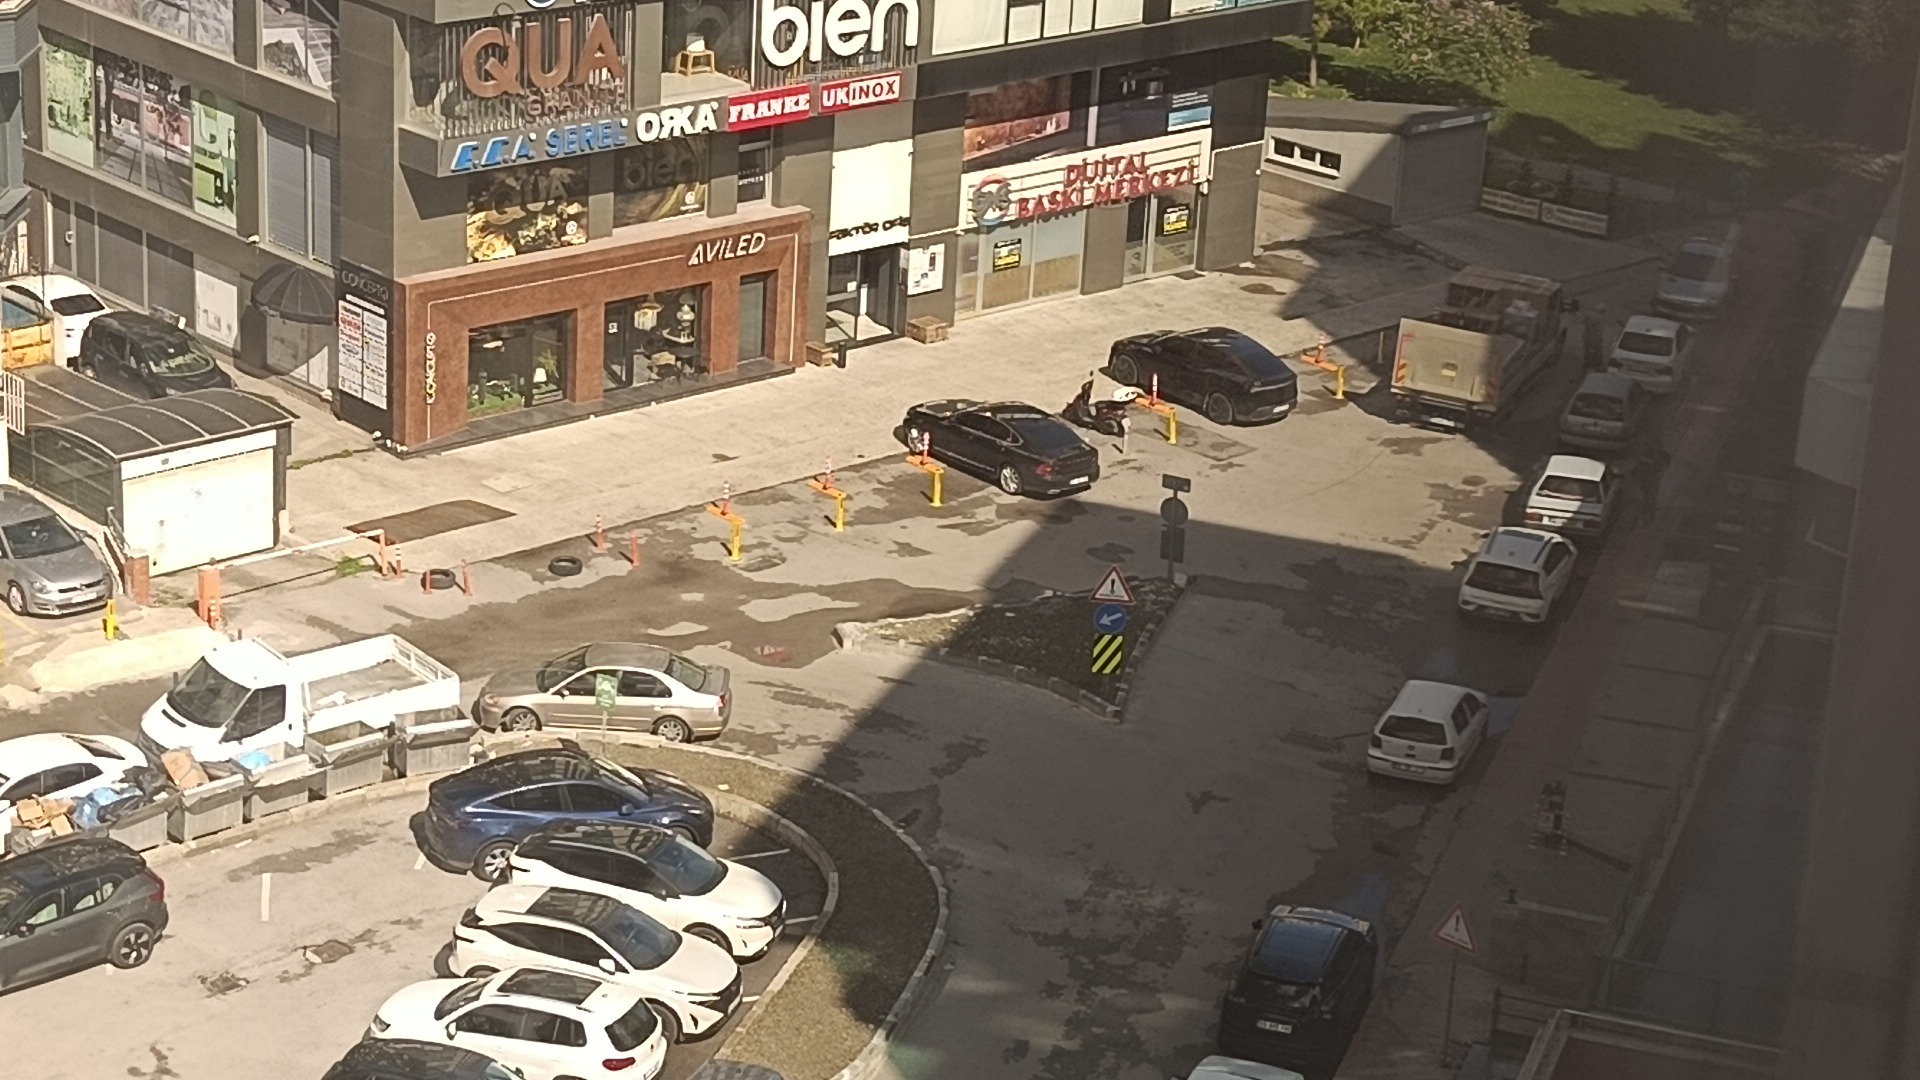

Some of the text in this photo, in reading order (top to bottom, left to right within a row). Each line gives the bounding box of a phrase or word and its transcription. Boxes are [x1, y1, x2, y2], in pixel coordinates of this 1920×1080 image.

[462, 13, 626, 98] QUA
[761, 0, 919, 67] bien
[728, 93, 810, 123] FRANKE
[688, 232, 766, 266] AVILED
